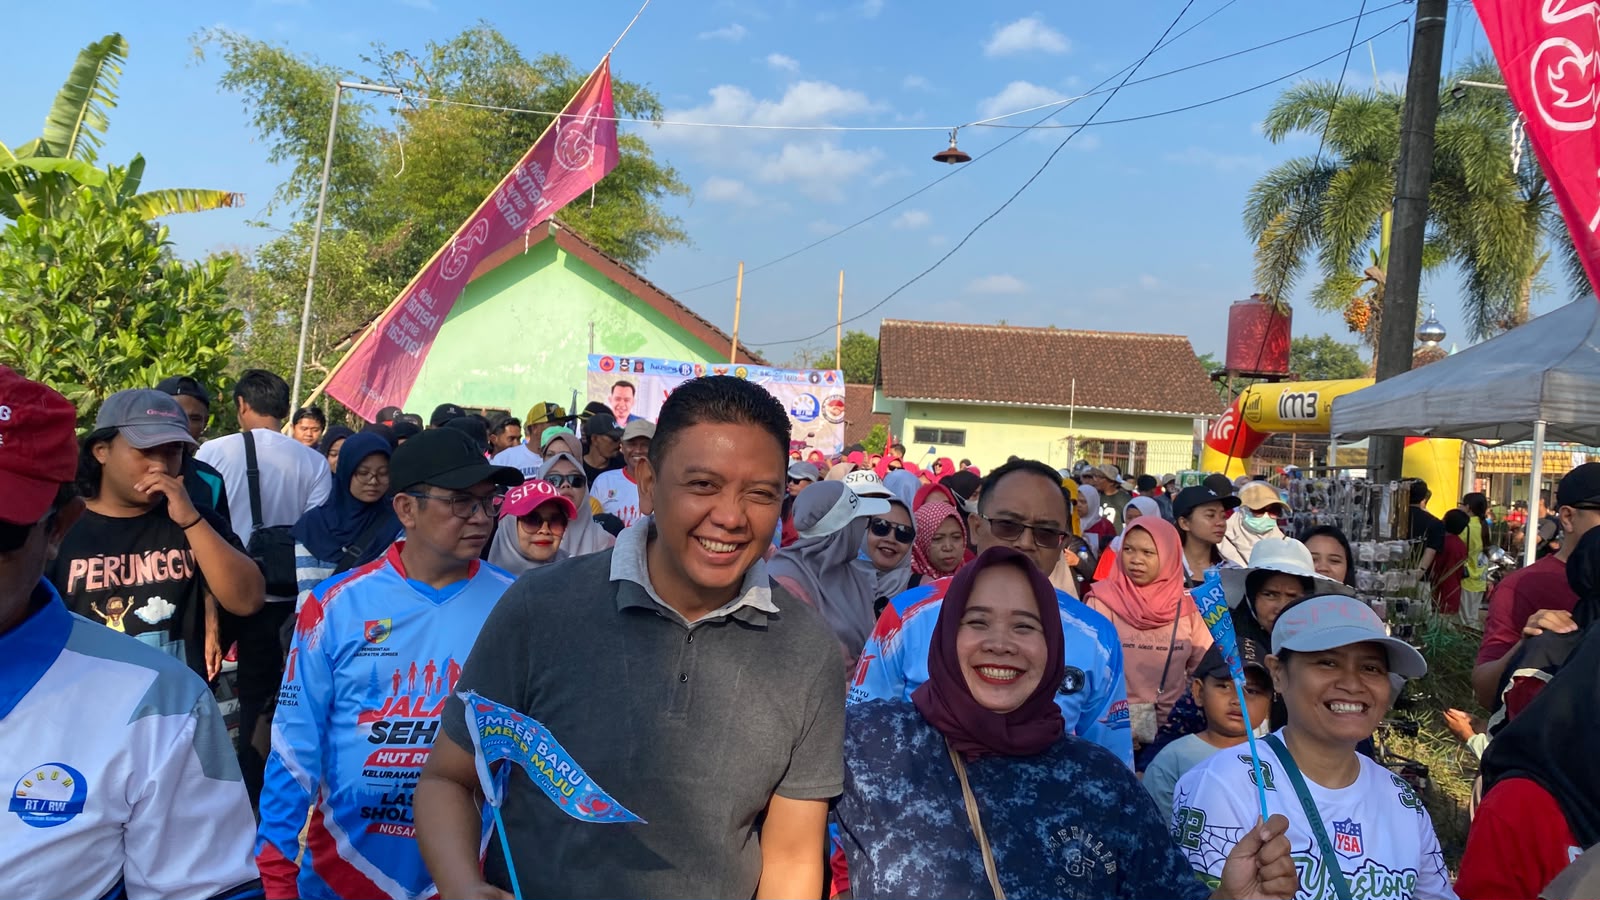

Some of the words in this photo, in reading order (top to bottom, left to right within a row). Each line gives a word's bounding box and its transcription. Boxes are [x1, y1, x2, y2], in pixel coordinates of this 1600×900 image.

[67, 548, 195, 593] PERUNGGU
[281, 684, 301, 692] HAYU
[367, 721, 439, 744] SEH
[376, 752, 410, 764] HUT
[536, 741, 584, 786] BARU
[531, 754, 576, 798] MAJU
[25, 799, 39, 810] RT
[48, 801, 67, 811] RW
[360, 806, 414, 823] SHOL
[1337, 834, 1361, 853] YSA
